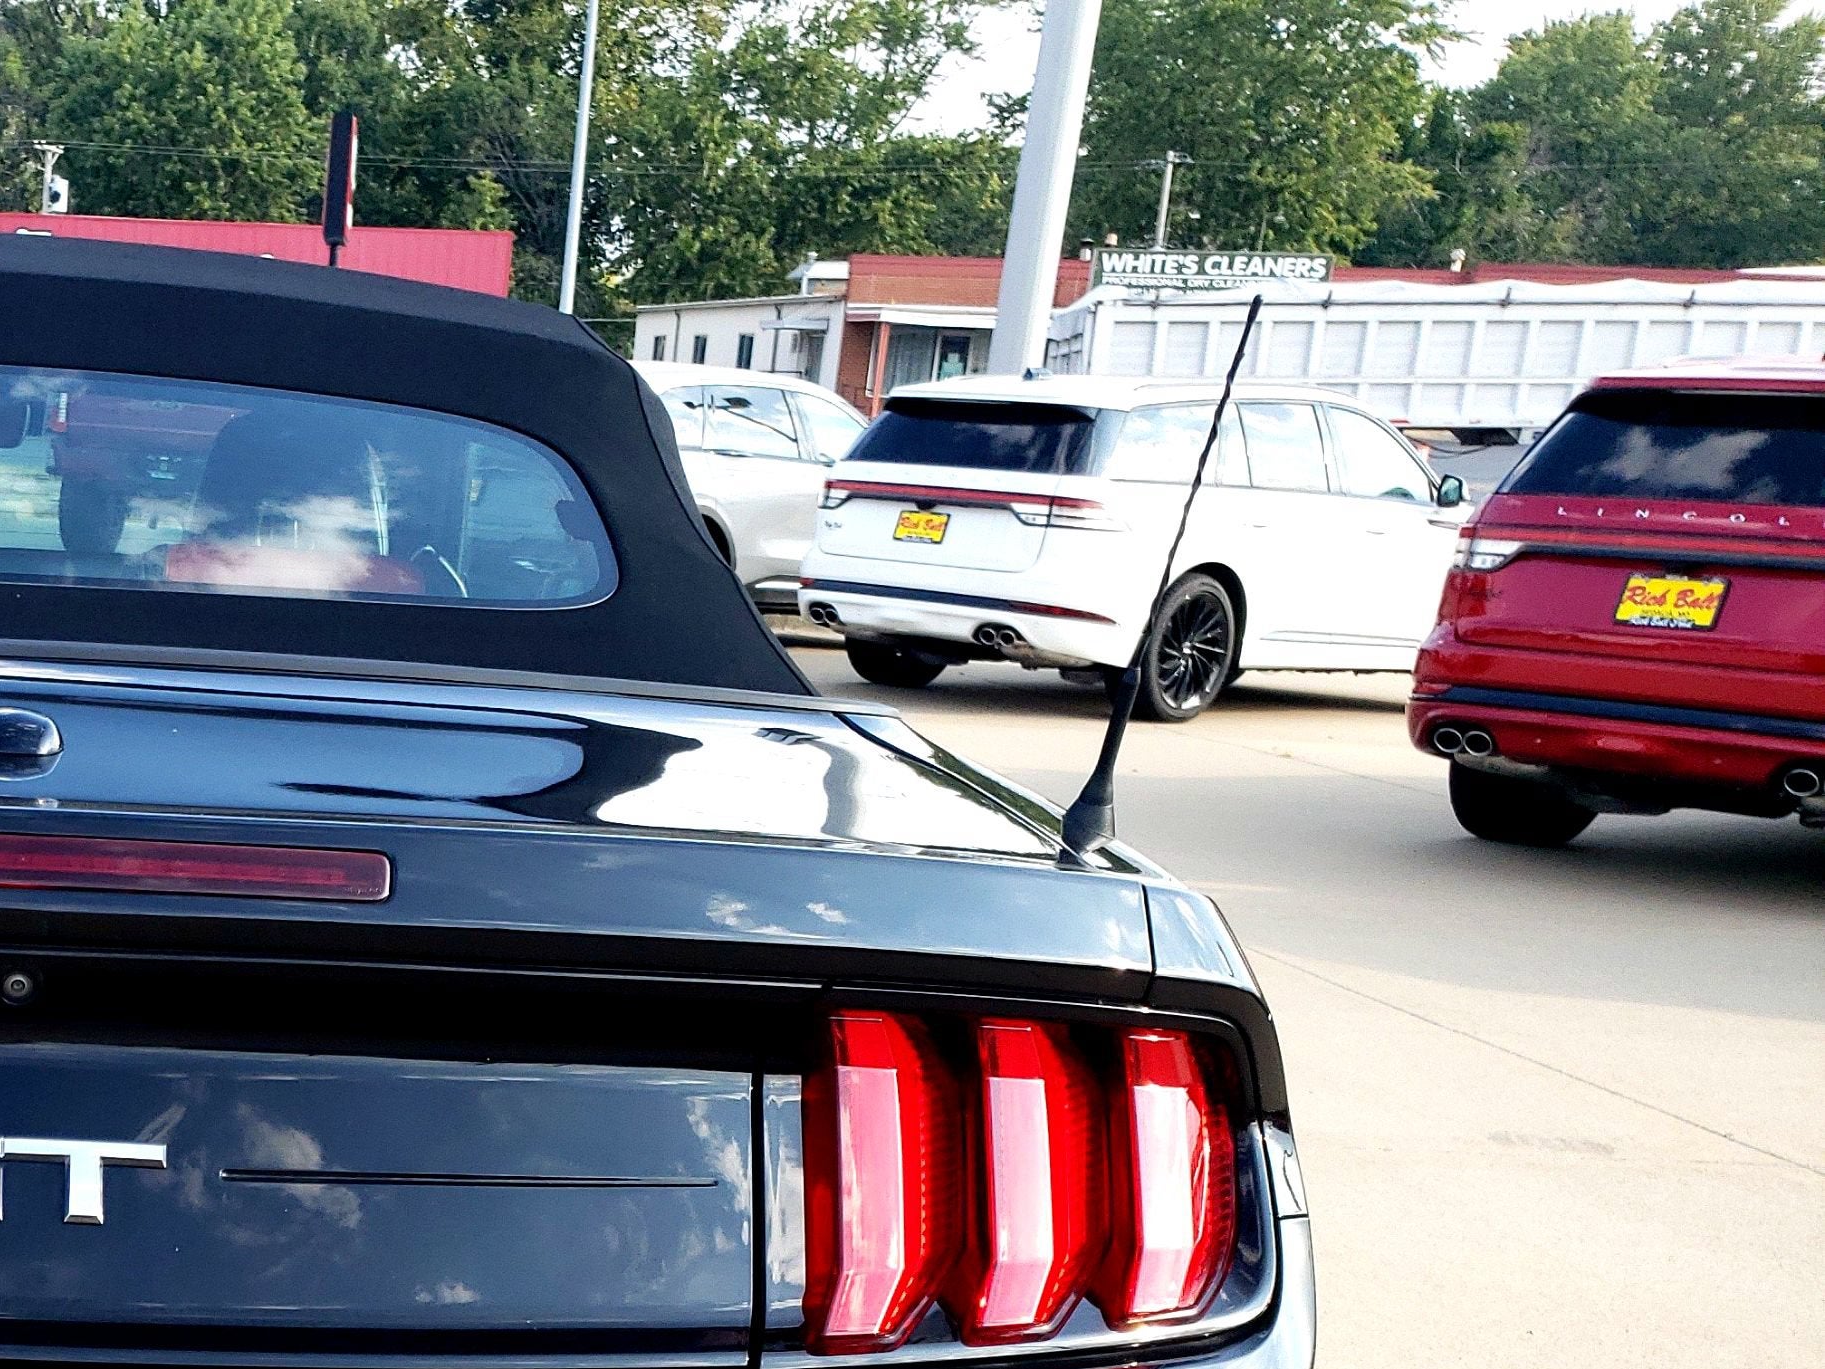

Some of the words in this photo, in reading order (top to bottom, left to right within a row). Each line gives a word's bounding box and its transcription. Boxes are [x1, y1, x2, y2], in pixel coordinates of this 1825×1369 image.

[1101, 252, 1200, 276] WHITE'S
[1203, 255, 1328, 279] CLEANERS
[1557, 505, 1825, 527] LINCOL
